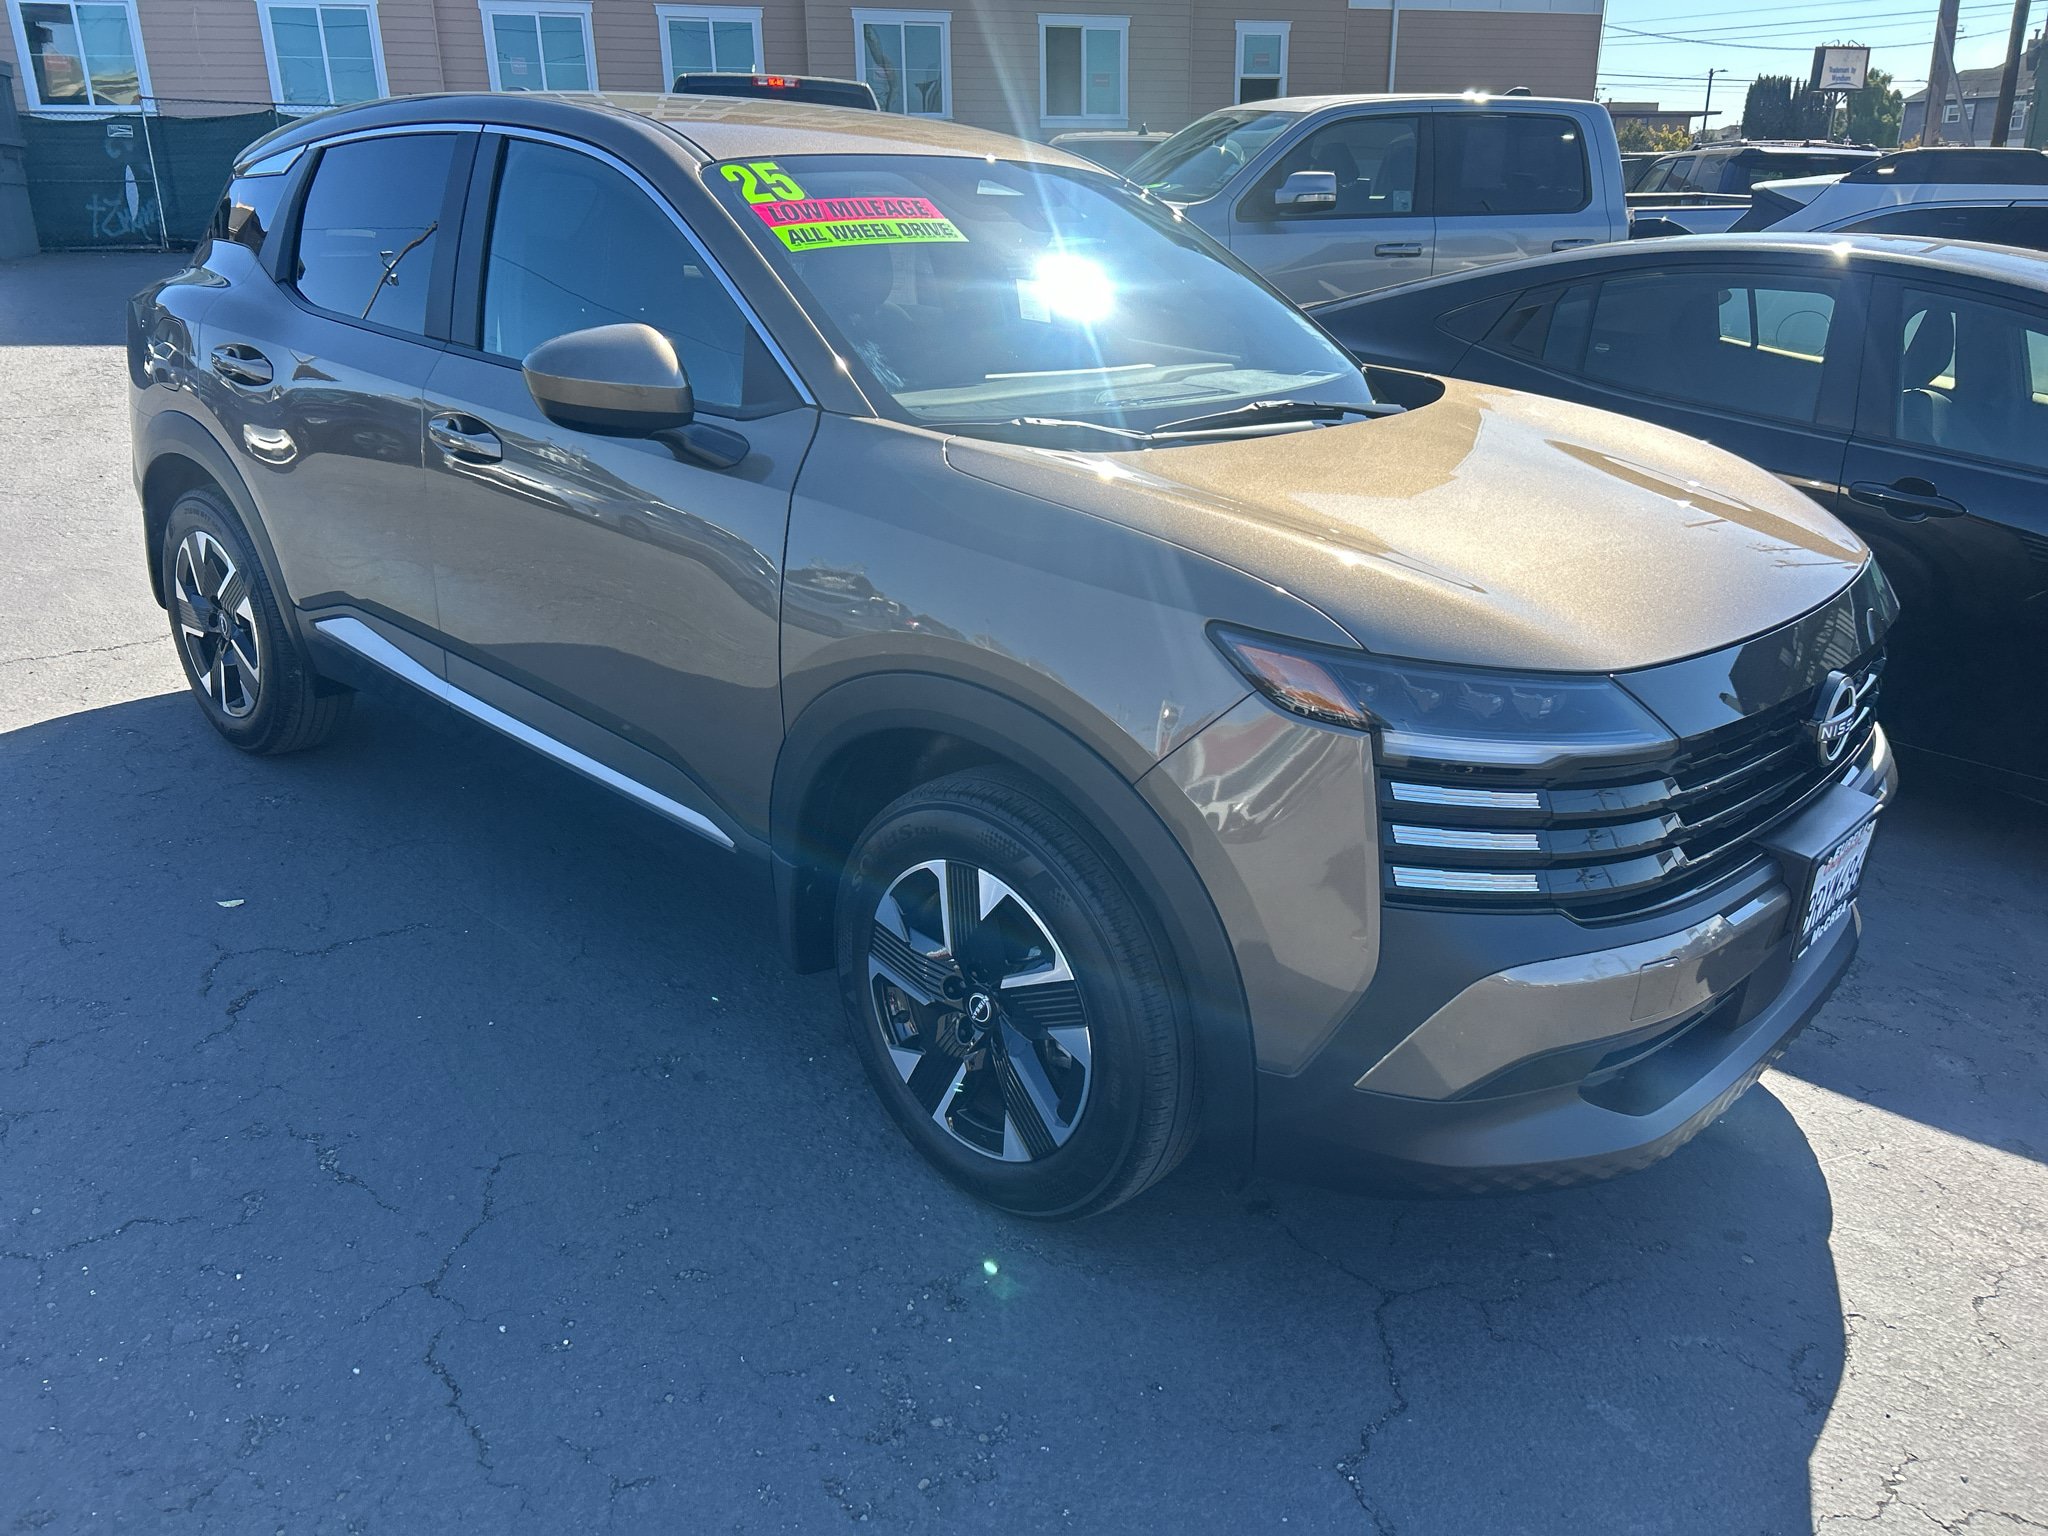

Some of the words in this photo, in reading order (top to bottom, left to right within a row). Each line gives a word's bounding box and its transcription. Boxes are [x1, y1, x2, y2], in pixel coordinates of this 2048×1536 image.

[720, 162, 805, 204] 25
[767, 202, 823, 222] LOW
[824, 199, 930, 219] MILEAGE
[787, 226, 829, 244] ALL
[826, 222, 898, 241] WHEEL
[896, 222, 954, 237] DRIVE
[1810, 899, 1847, 945] McCREA
